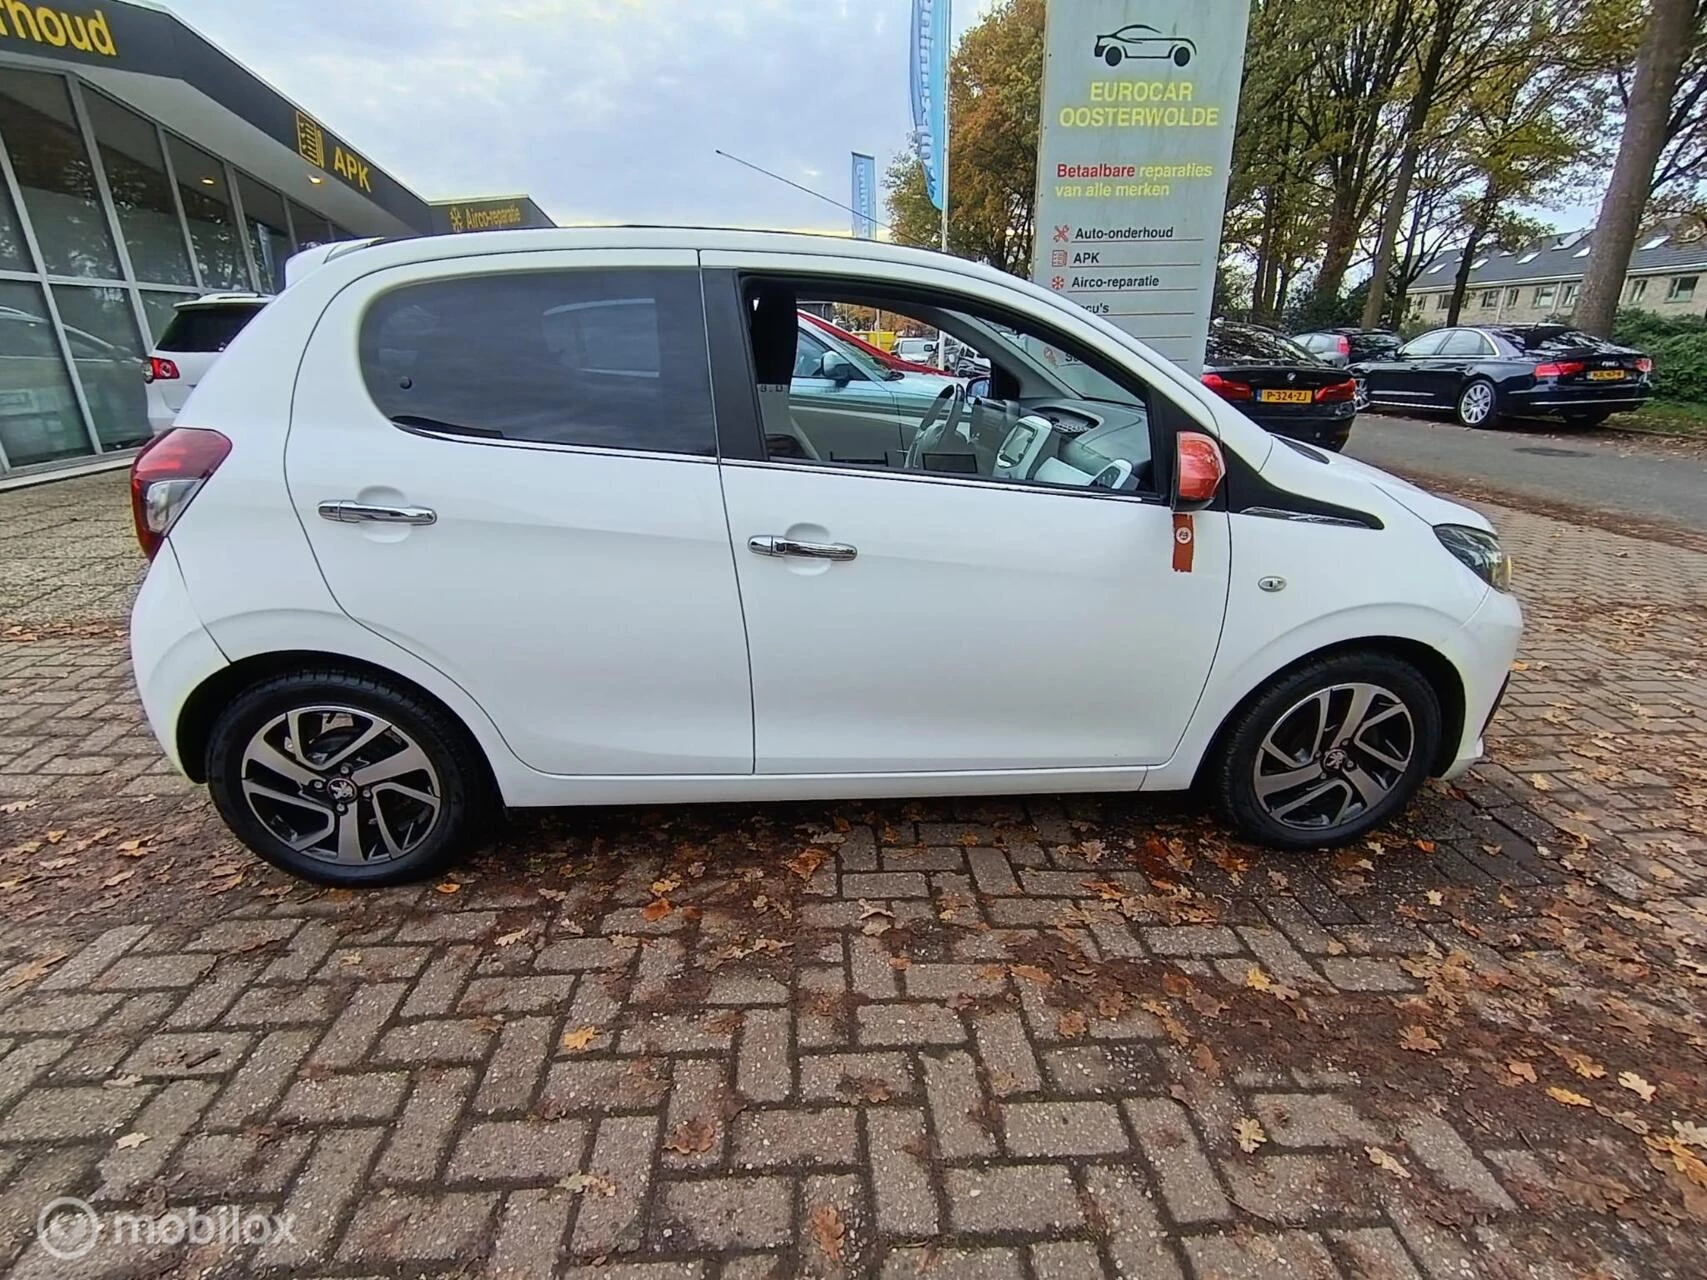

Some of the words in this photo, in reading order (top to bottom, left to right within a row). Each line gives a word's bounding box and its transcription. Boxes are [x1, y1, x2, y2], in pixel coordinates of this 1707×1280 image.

[1090, 81, 1193, 102] EUROCAR
[1059, 107, 1219, 127] OOSTERWOLDE
[334, 146, 372, 193] APK
[1057, 163, 1135, 178] Betaalbare
[1139, 163, 1213, 181] reparaties
[1055, 185, 1081, 197] van
[1085, 183, 1112, 197] alle
[1116, 183, 1170, 197] merken
[466, 204, 521, 230] Airco-reparatie
[1075, 226, 1174, 240] Auto-onderhoud
[1073, 252, 1100, 264] APK
[1071, 275, 1160, 290] Airco-reparatie
[1080, 302, 1110, 314] cu's
